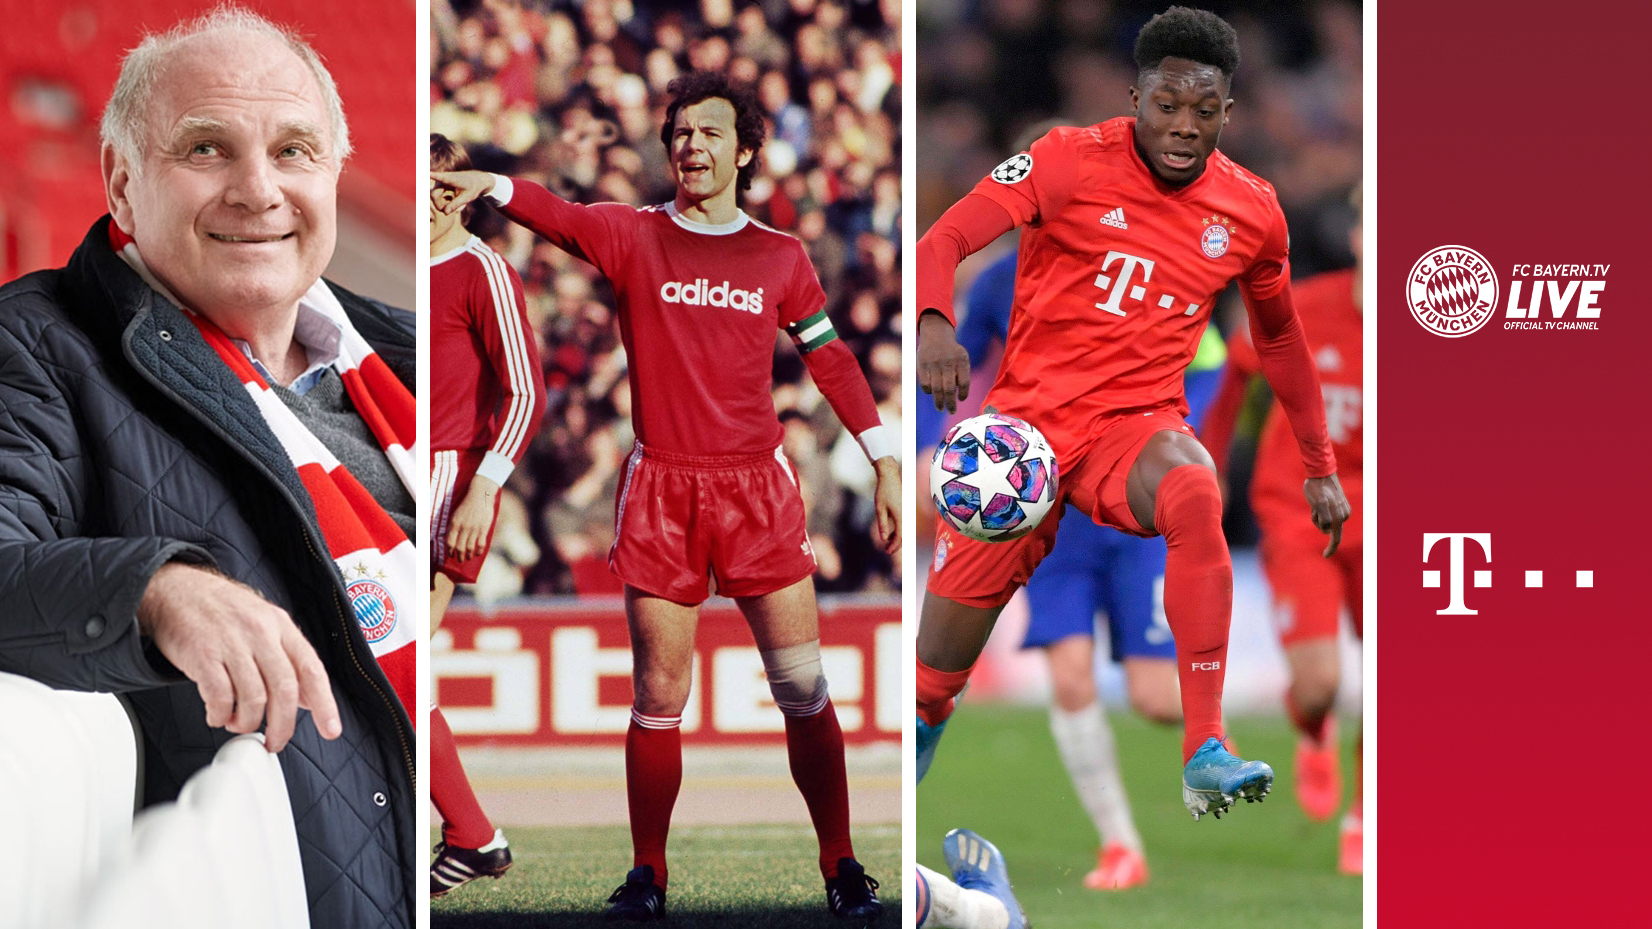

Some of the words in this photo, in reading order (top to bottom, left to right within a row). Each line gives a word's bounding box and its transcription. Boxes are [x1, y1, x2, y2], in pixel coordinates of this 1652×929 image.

[1099, 217, 1128, 230] adidas
[660, 278, 764, 315] adidas
[363, 610, 394, 640] NCHEN
[1191, 661, 1221, 672] FCB
